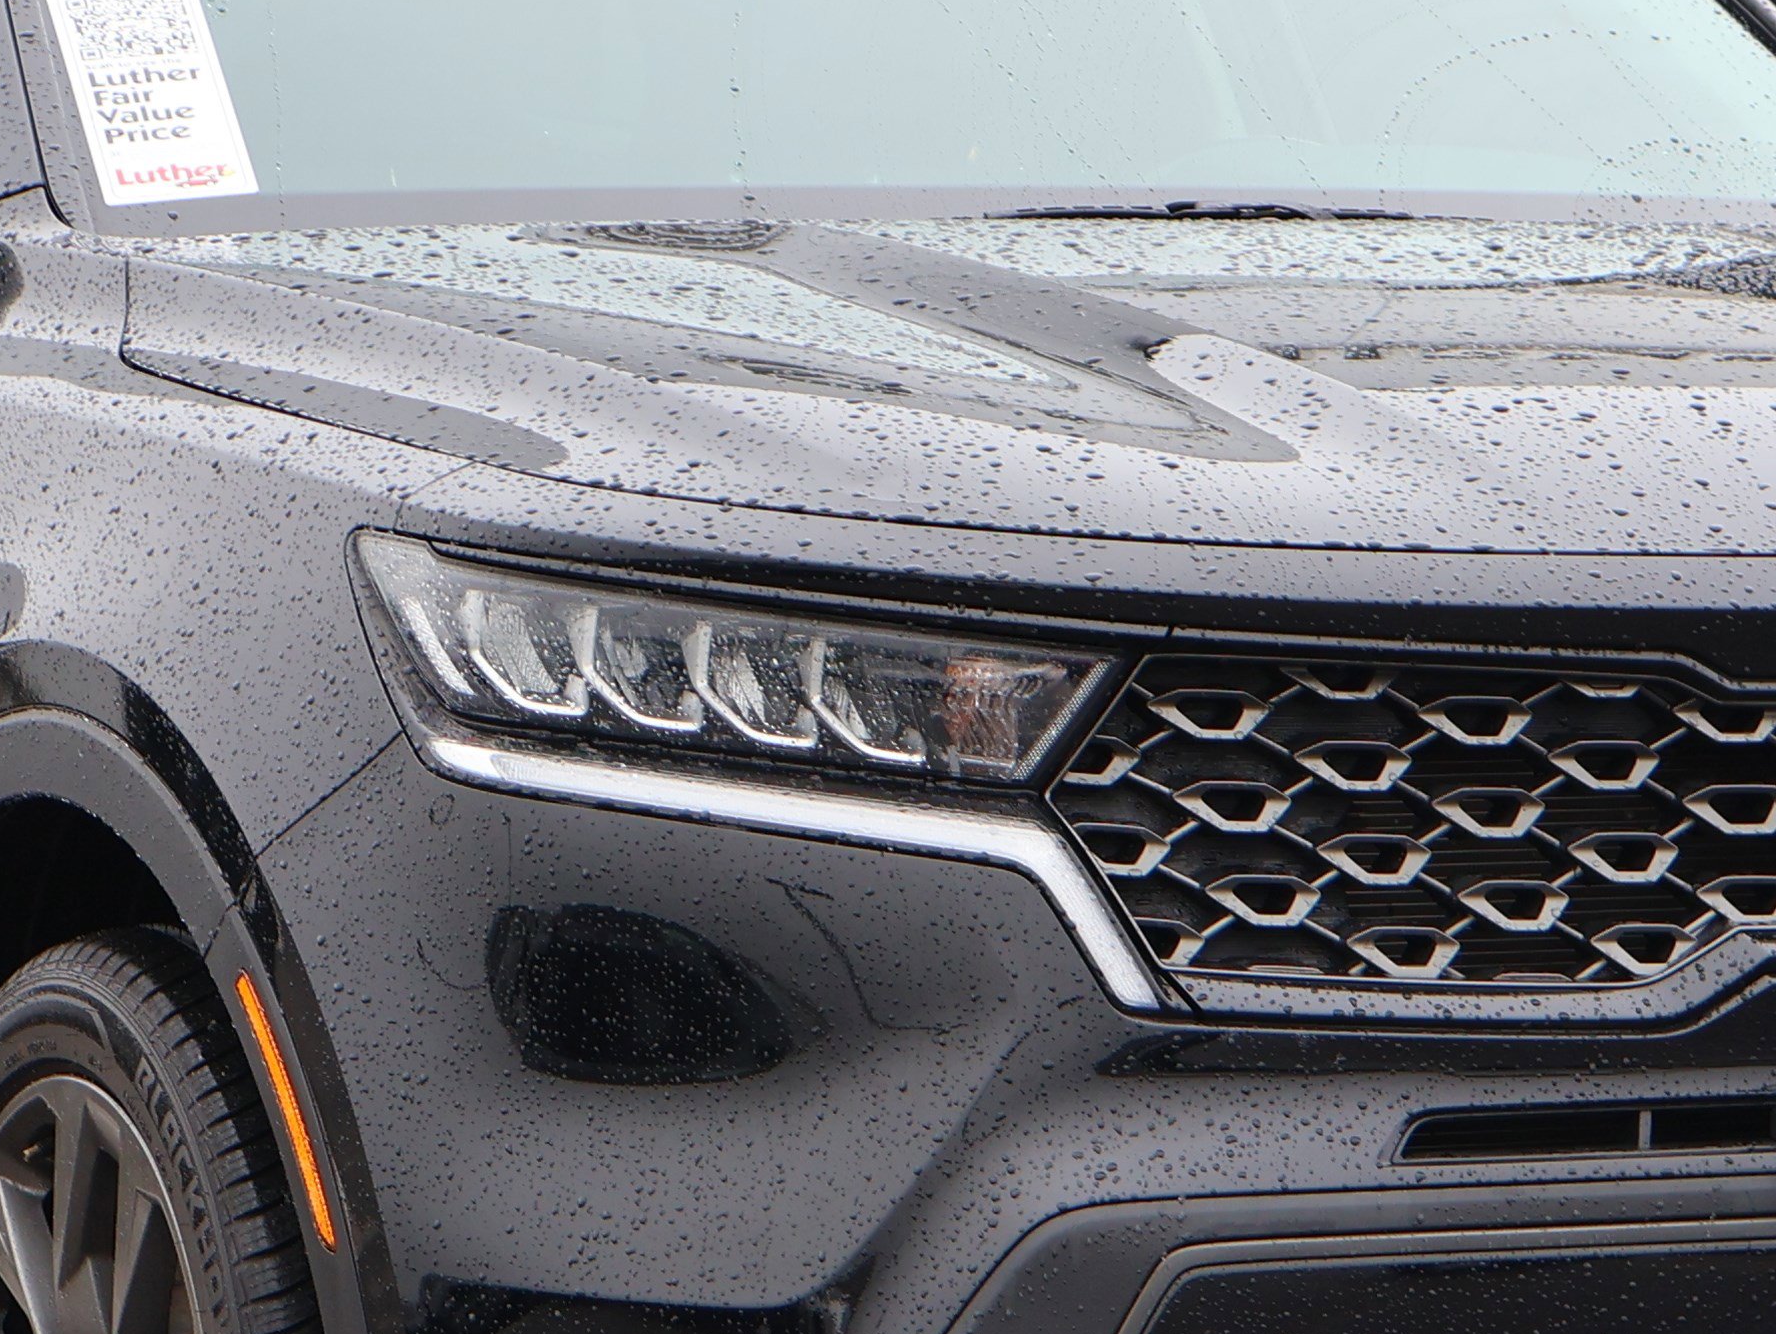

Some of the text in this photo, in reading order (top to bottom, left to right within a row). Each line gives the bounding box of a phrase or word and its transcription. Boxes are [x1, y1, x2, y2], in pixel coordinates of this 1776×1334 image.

[87, 66, 201, 88] Luther
[92, 86, 154, 107] Fair
[96, 104, 196, 125] Value
[103, 124, 192, 145] Price
[115, 163, 230, 187] Luther
